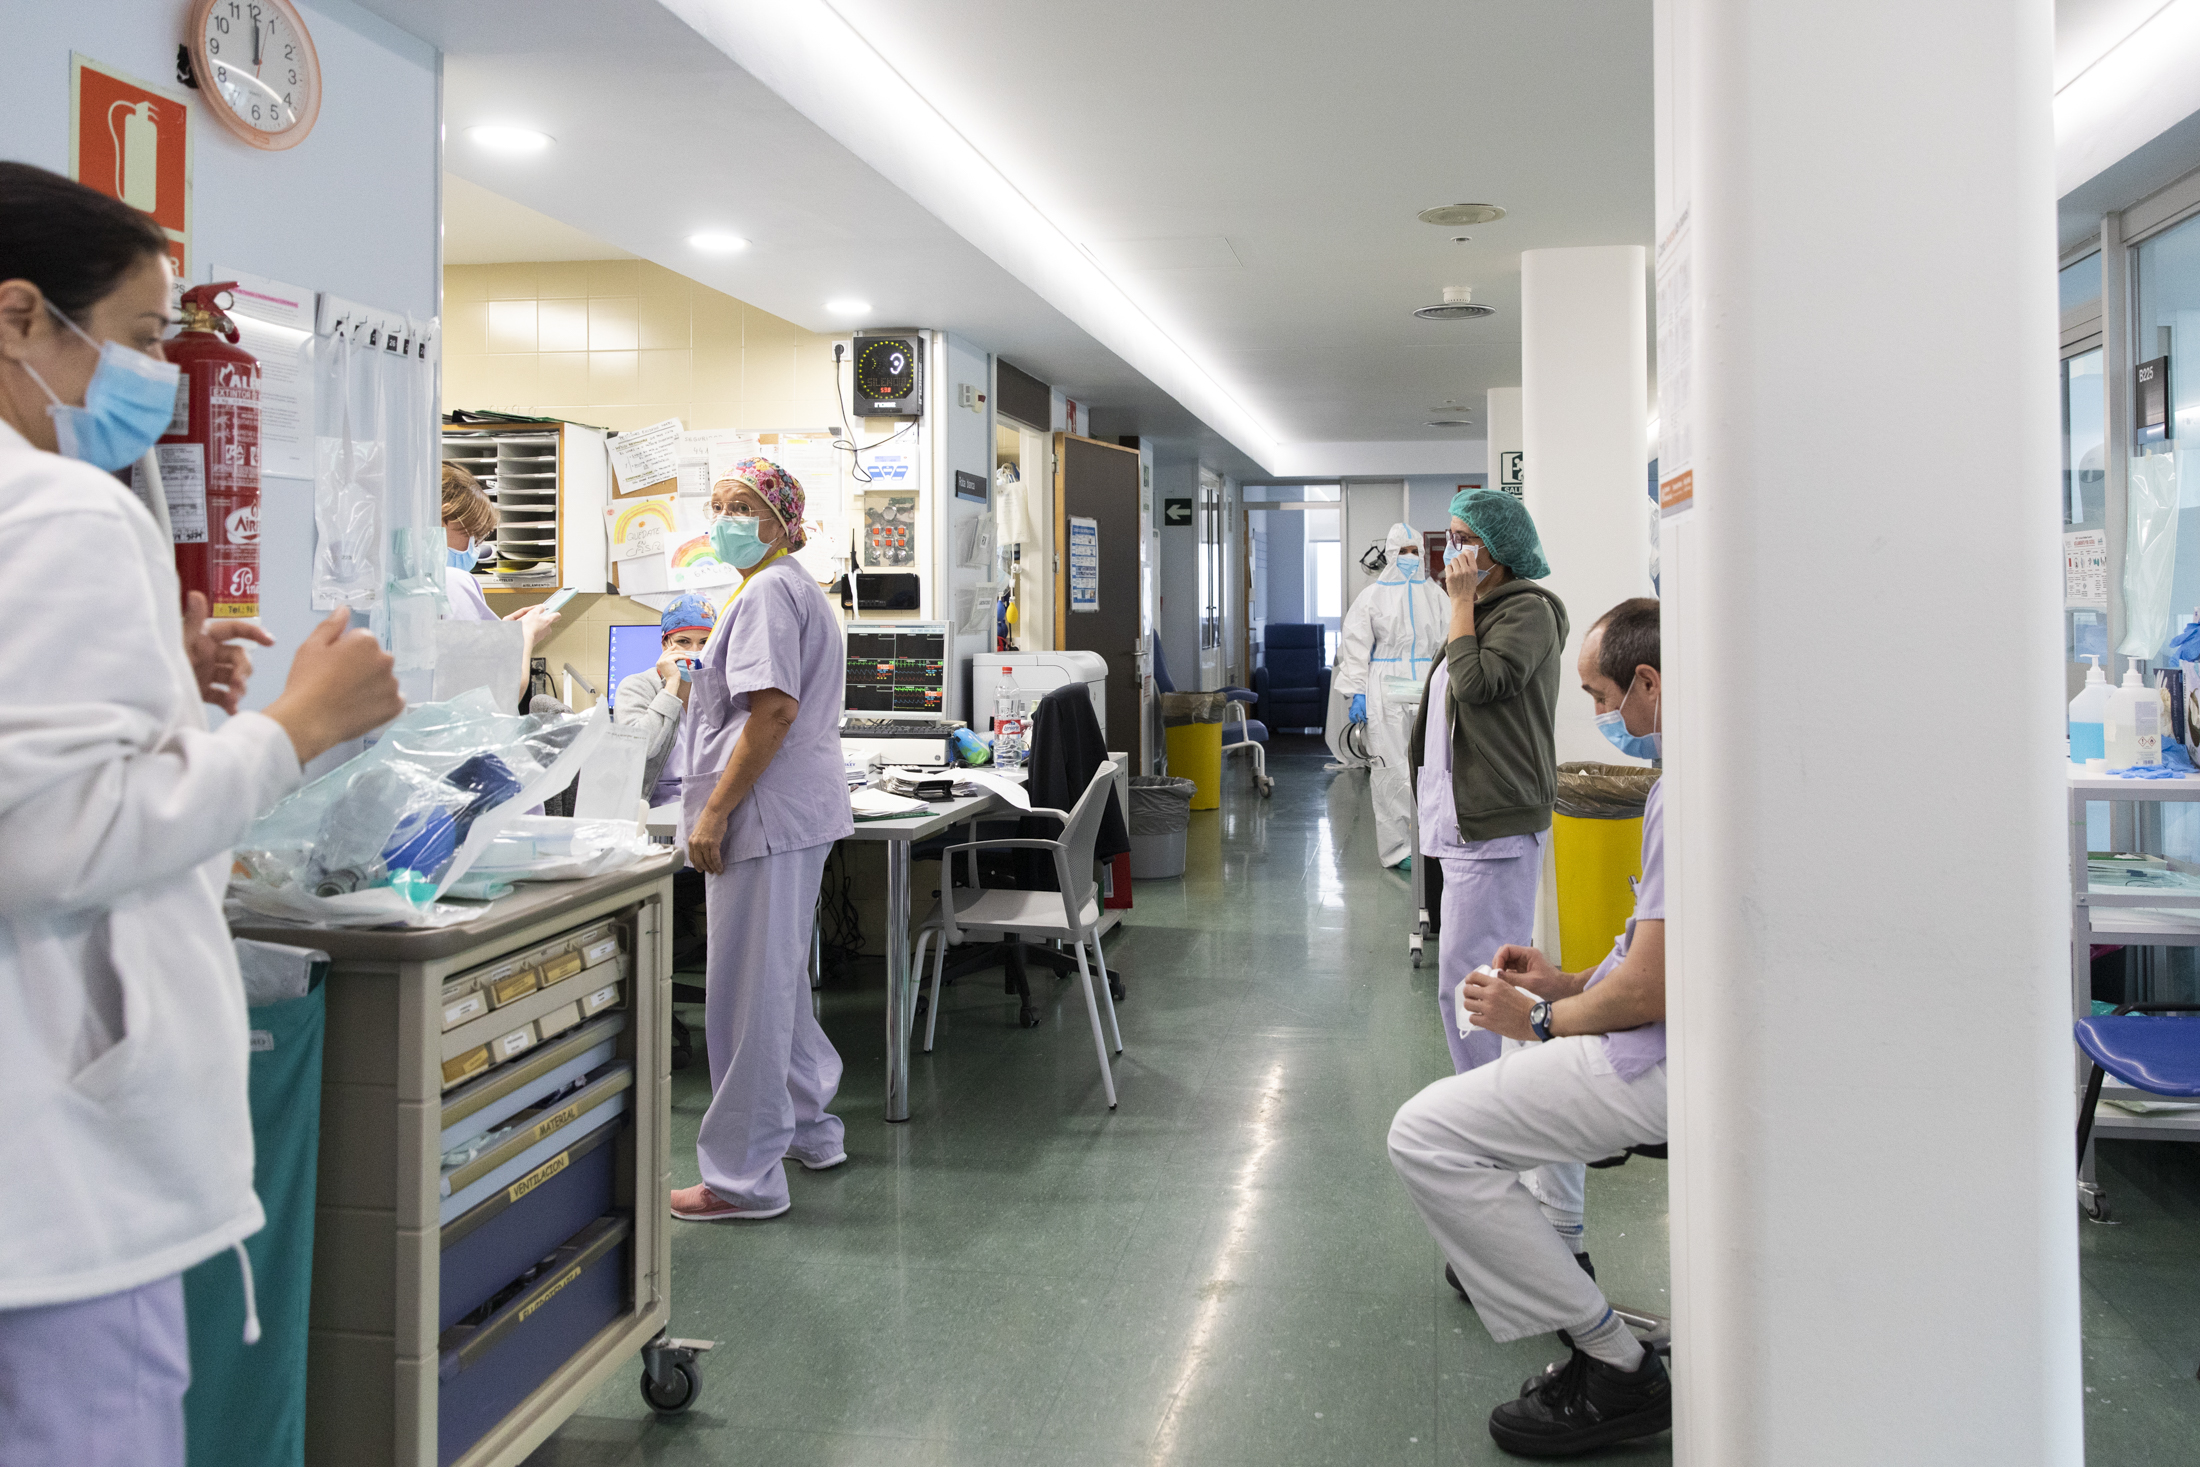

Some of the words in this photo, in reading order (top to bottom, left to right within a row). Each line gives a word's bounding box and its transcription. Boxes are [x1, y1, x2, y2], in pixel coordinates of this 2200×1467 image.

[228, 2, 240, 20] 11
[247, 3, 262, 23] 12
[214, 15, 229, 34] 10
[269, 19, 276, 35] 1
[209, 37, 220, 55] 9
[284, 44, 293, 61] 2
[217, 66, 227, 83] 8
[287, 69, 297, 85] 3
[283, 92, 293, 107] 4
[251, 104, 261, 120] 6
[270, 104, 279, 120] 5
[2139, 366, 2153, 383] B225
[539, 1107, 576, 1135] MATERIAL
[513, 1156, 564, 1198] VENTILACION
